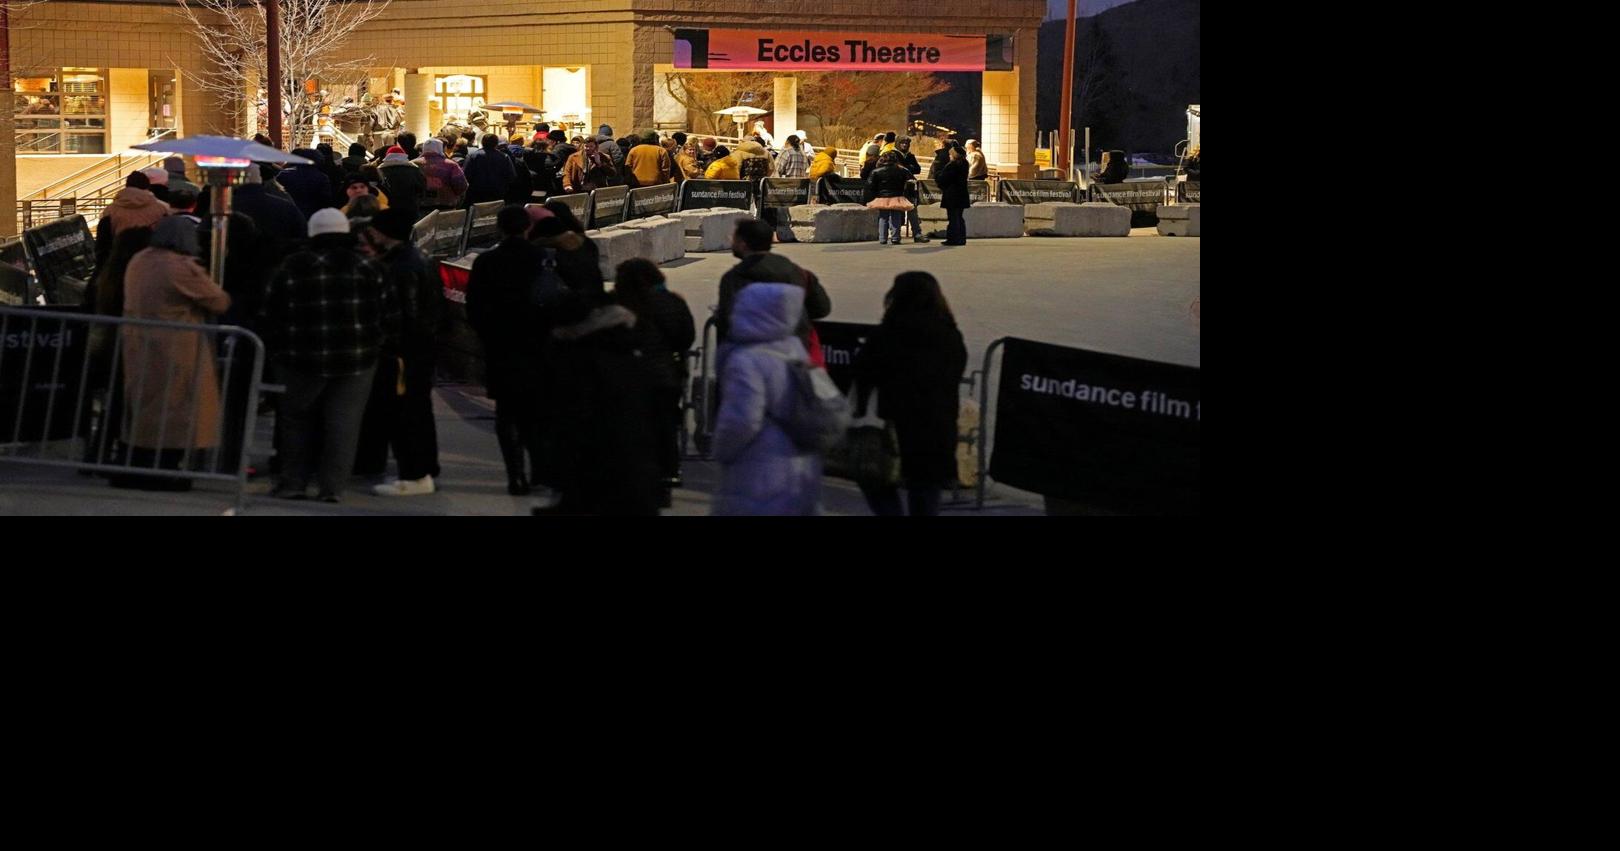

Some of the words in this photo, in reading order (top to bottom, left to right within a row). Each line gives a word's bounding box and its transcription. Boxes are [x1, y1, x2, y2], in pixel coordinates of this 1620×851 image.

[757, 38, 841, 63] Eccles
[844, 39, 941, 63] Theatre
[691, 190, 717, 199] sundance
[728, 190, 747, 199] festival
[1020, 373, 1137, 409] sundance
[1139, 390, 1192, 419] film
